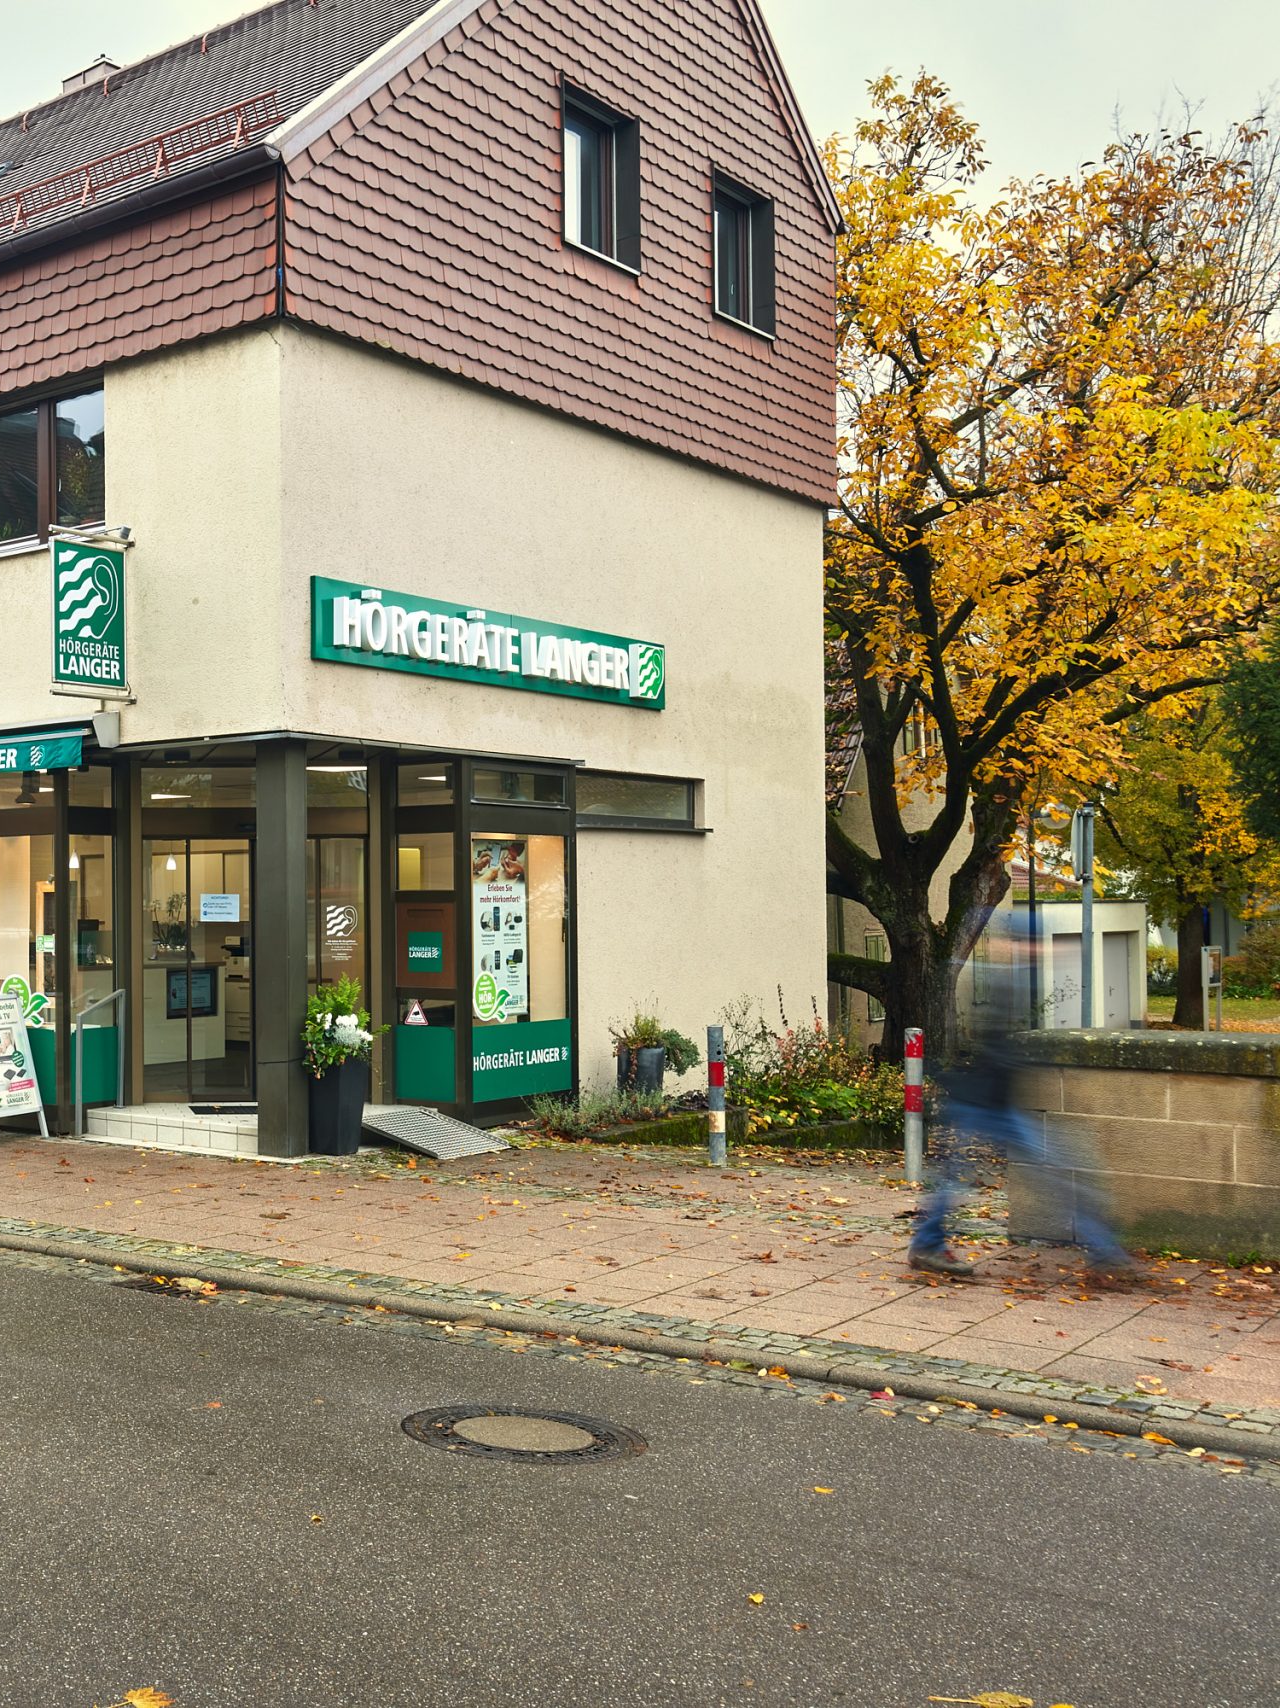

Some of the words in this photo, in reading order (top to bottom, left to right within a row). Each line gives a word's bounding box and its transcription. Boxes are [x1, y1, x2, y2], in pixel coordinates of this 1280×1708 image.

[60, 636, 120, 659] HÖRGERÄTE
[333, 588, 520, 673] HÖRGERÄTE
[521, 631, 630, 690] LANGER
[60, 654, 120, 680] LANGER
[487, 884, 505, 892] Erleben
[505, 884, 513, 892] Sie
[408, 951, 432, 959] LANGER
[3, 1012, 11, 1020] TV
[473, 1048, 524, 1071] HÖRGERÄTE
[526, 1047, 560, 1065] LANGER
